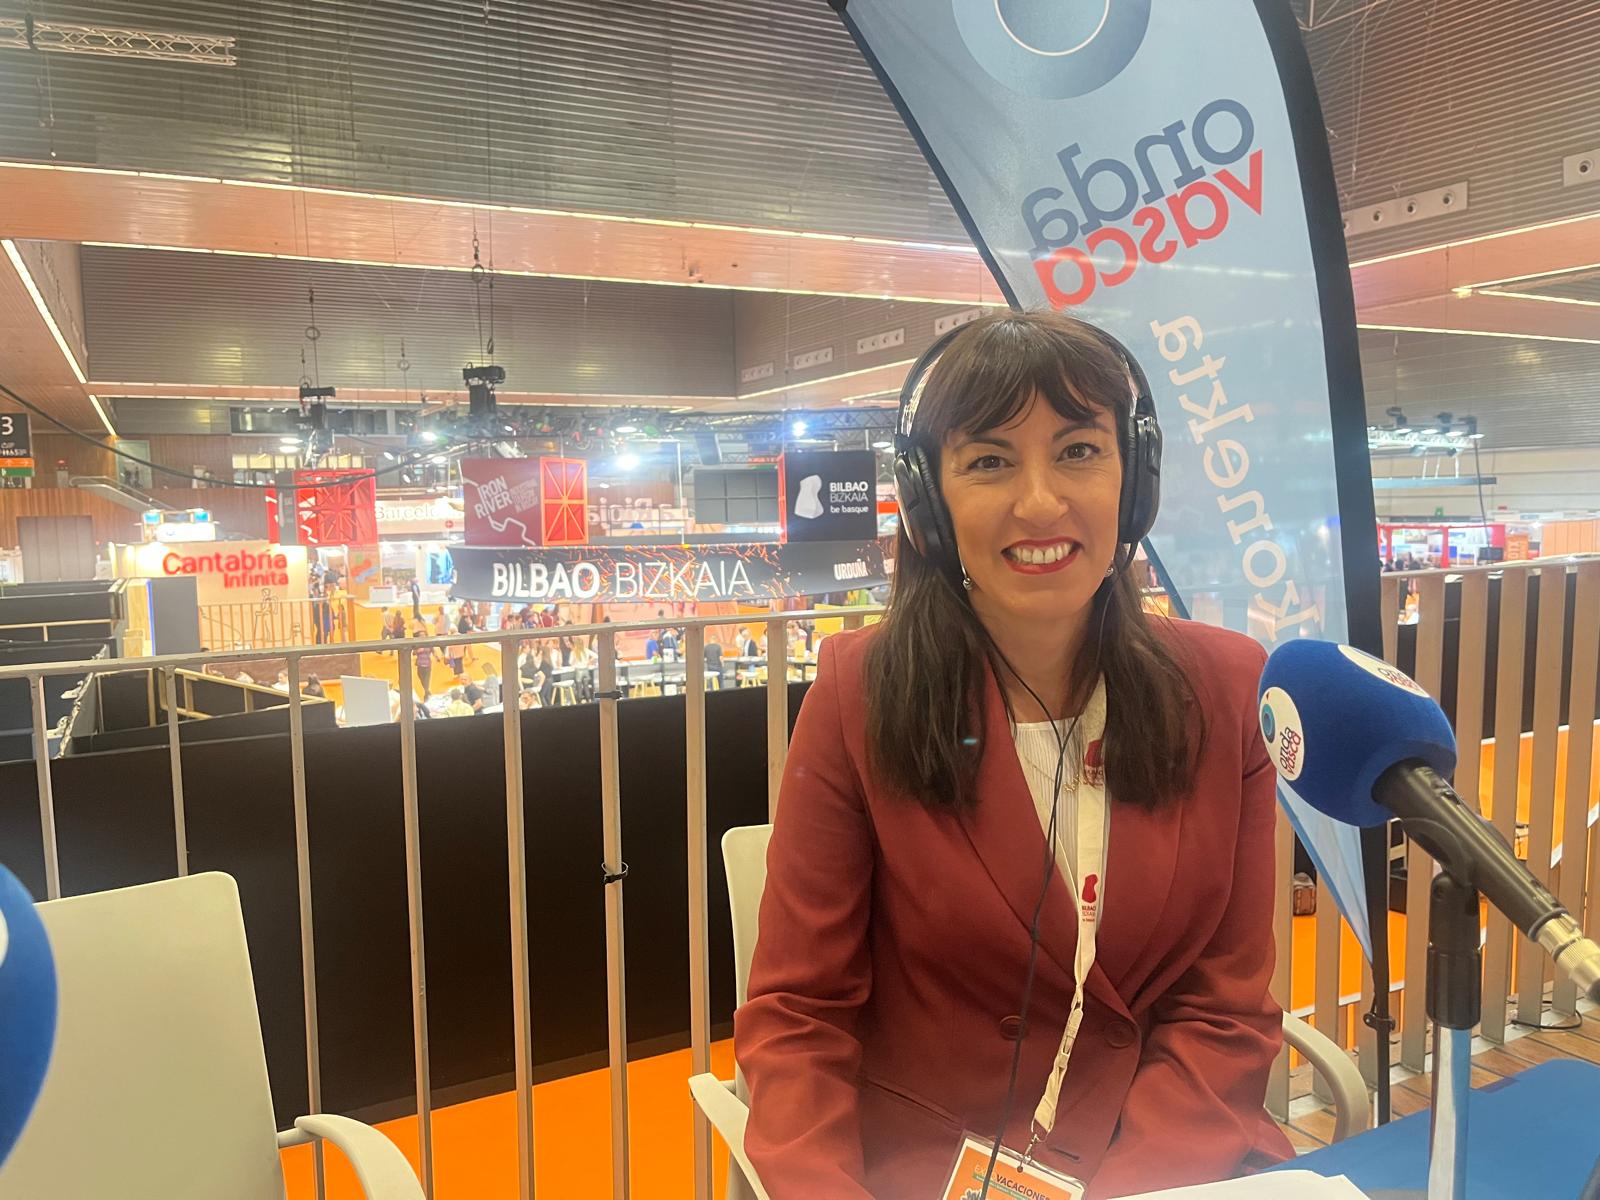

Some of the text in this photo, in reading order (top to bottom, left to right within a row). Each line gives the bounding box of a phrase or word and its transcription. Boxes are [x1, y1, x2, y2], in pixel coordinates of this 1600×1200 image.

[477, 475, 508, 500] IRON
[829, 481, 869, 492] BILBAO
[829, 492, 869, 503] BIZKAIA
[474, 490, 513, 519] RIVER
[830, 505, 869, 515] be basque
[491, 559, 755, 599] BILBAO BIZKAIA
[833, 558, 869, 581] URDUÑA
[1280, 726, 1294, 770] onda
[1286, 730, 1302, 775] vasca
